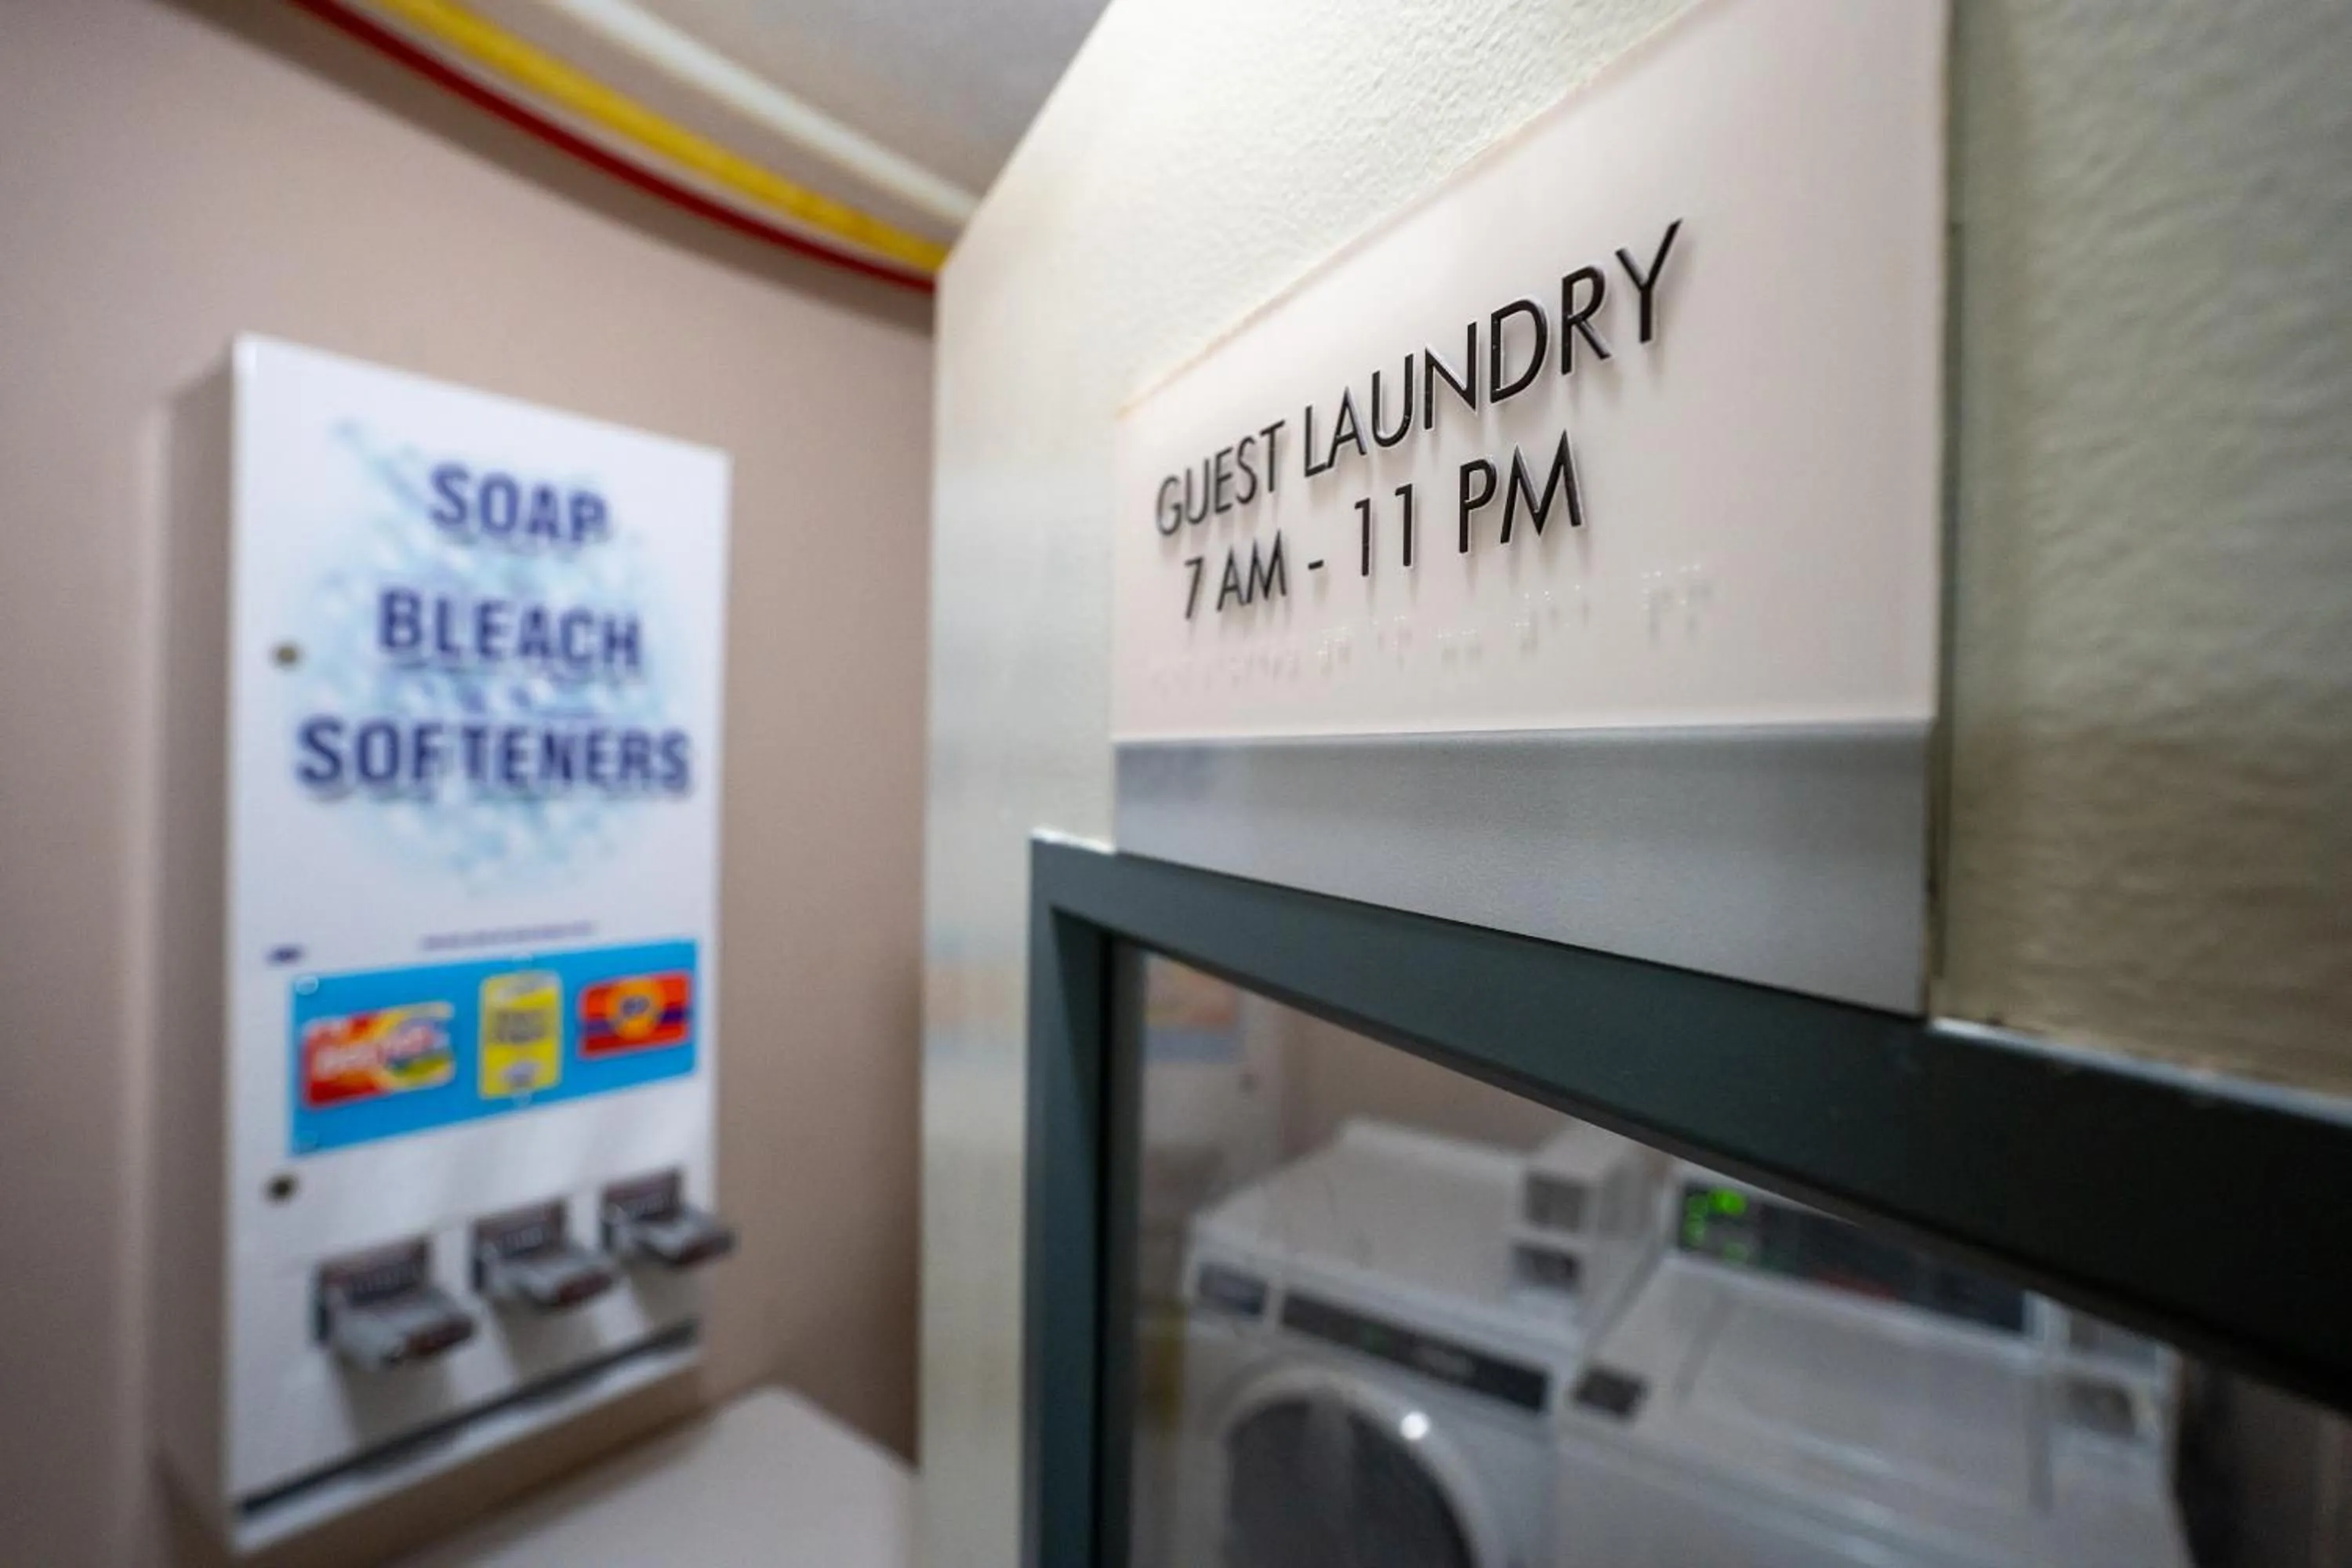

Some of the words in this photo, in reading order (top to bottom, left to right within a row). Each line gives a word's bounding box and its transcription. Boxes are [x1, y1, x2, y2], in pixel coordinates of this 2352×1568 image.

[1156, 420, 1286, 537] GUEST
[1304, 218, 1684, 478] LAUNDRY
[429, 461, 611, 543] SOAP
[1184, 557, 1205, 619] 7
[1218, 530, 1287, 612] AM
[1308, 559, 1325, 571] -
[1354, 483, 1414, 577] 11
[1459, 428, 1584, 554] PM
[377, 587, 643, 668] BLEACH
[296, 715, 691, 793] SOFTENERS
